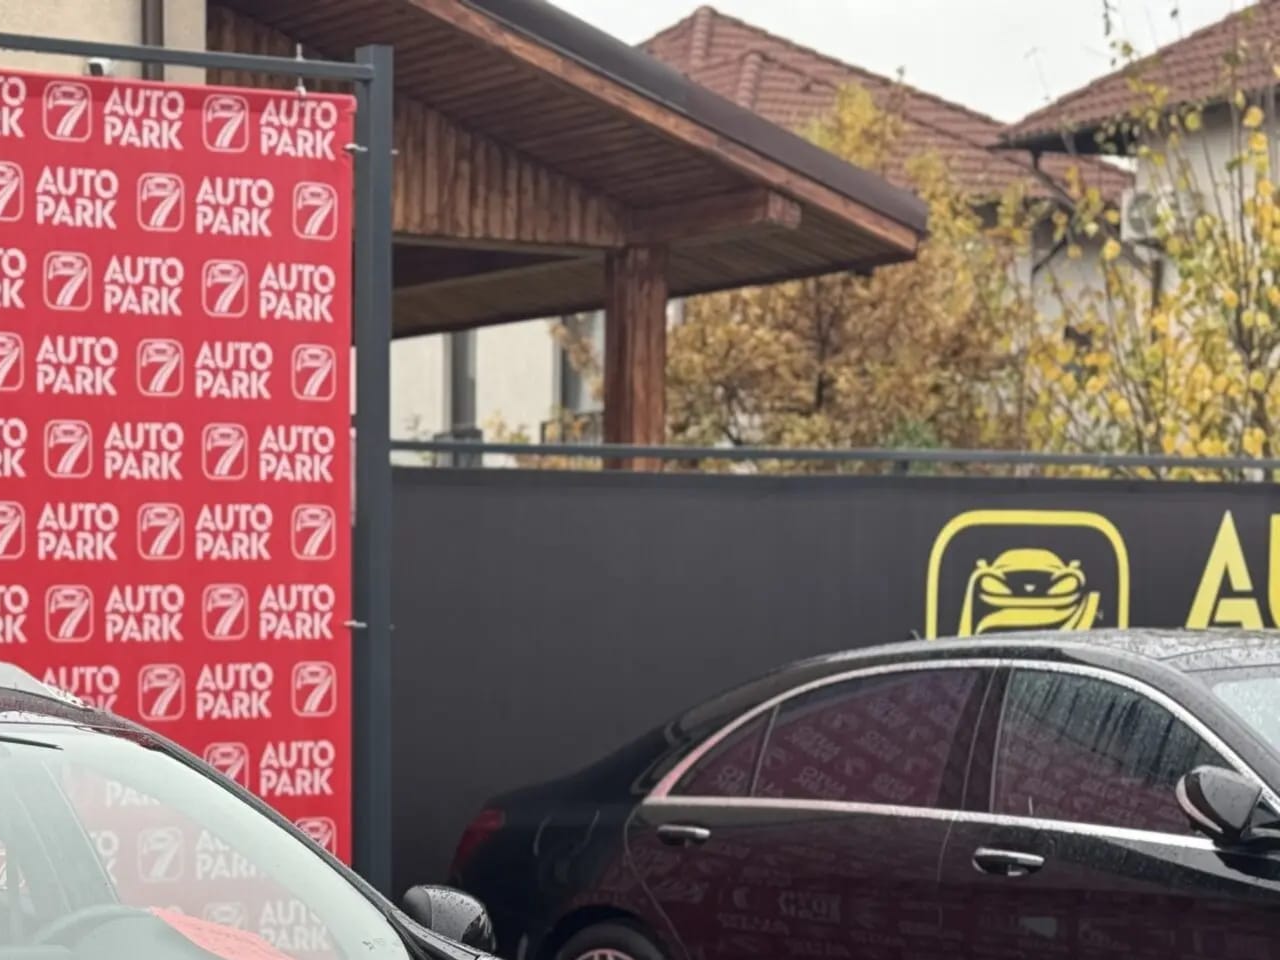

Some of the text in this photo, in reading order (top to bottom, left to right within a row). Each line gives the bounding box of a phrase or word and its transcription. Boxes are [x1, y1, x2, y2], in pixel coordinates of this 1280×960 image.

[104, 89, 184, 120] AUTO
[260, 100, 337, 128] AUTO
[104, 115, 183, 150] PARK
[260, 128, 335, 160] PARK
[36, 166, 119, 199] AUTO
[196, 177, 274, 206] AUTO
[36, 194, 116, 229] PARK
[196, 206, 271, 237] PARK
[104, 256, 184, 285] AUTO
[259, 263, 335, 291] AUTO
[104, 285, 181, 315] PARK
[260, 291, 333, 322] PARK
[36, 336, 118, 365] AUTO
[195, 342, 273, 369] AUTO
[37, 365, 116, 395] PARK
[195, 369, 270, 399] PARK
[104, 422, 184, 450] AUTO
[259, 425, 335, 453] AUTO
[105, 450, 181, 480] PARK
[260, 453, 332, 482] PARK
[37, 503, 119, 531] AUTO
[196, 504, 273, 532] AUTO
[38, 531, 116, 560] PARK
[196, 532, 270, 560] PARK
[106, 584, 184, 613] AUTO
[259, 584, 335, 612] AUTO
[106, 613, 182, 641] PARK
[260, 612, 332, 639] PARK
[196, 662, 273, 691] AUTO
[197, 691, 270, 719] PARK
[260, 740, 334, 768] AUTO
[260, 768, 332, 796] PARK
